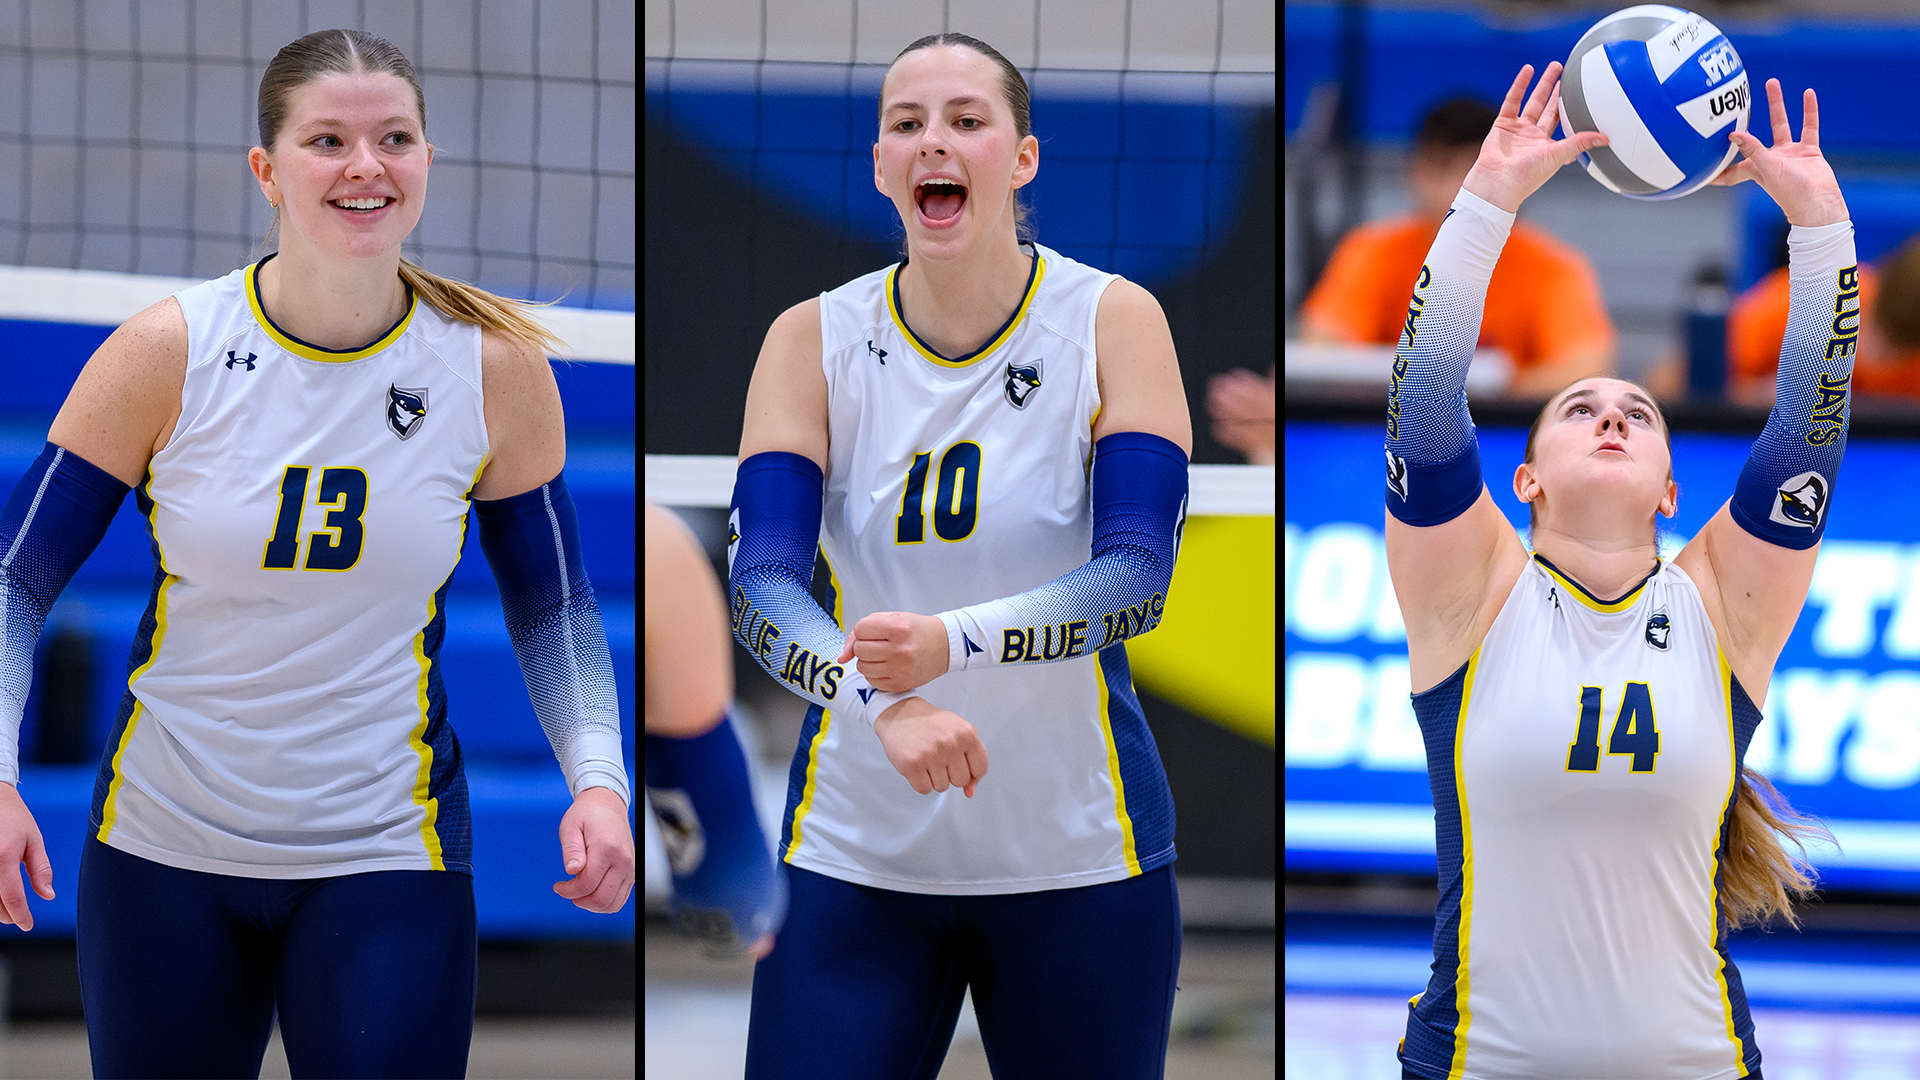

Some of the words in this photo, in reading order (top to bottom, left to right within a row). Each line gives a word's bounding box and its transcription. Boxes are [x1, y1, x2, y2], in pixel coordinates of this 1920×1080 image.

[1699, 45, 1742, 85] CAA
[1709, 81, 1751, 117] olten
[1825, 264, 1860, 361] BLUE
[1806, 372, 1852, 447] JAYS
[260, 464, 370, 573] 13
[894, 440, 983, 546] 10
[732, 585, 783, 669] BLUE
[779, 640, 846, 702] JAYS
[1000, 618, 1089, 665] BLUE
[1095, 591, 1165, 653] JAYS
[1564, 680, 1662, 775] 14
